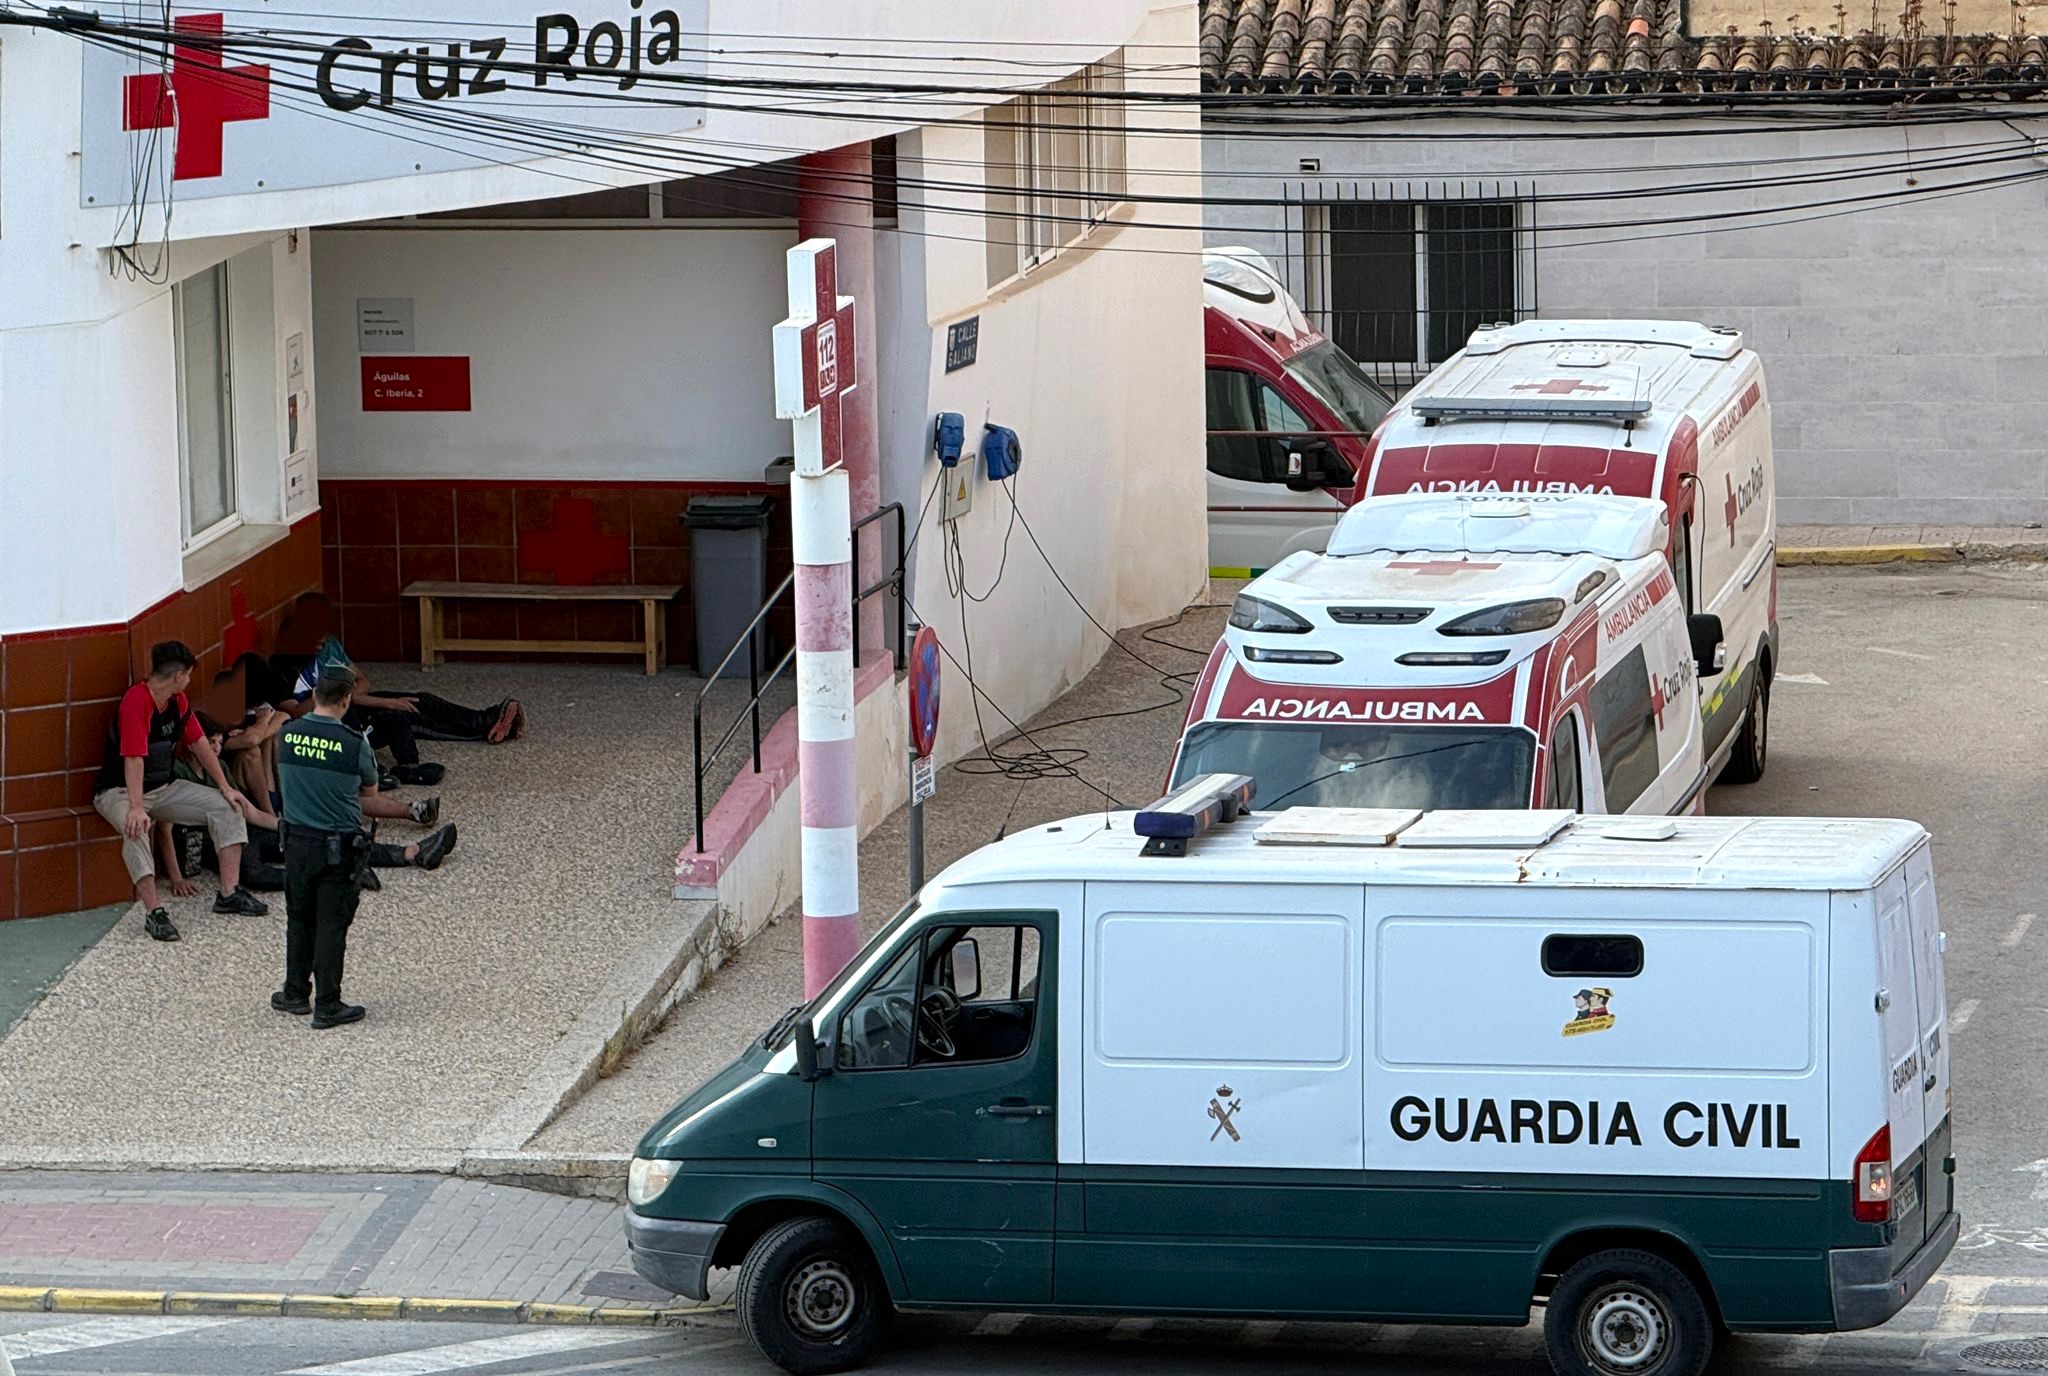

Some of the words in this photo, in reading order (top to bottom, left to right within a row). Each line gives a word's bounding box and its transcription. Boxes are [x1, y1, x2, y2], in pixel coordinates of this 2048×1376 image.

[316, 37, 506, 111] Cruz
[535, 0, 680, 91] Roja
[819, 335, 834, 366] 112
[373, 371, 410, 382] Águilas
[374, 389, 384, 398] C.
[386, 388, 415, 398] Iberia,
[417, 389, 424, 398] 2
[1712, 402, 1744, 449] AMBULANCIA
[1737, 483, 1752, 516] Cruz
[1751, 456, 1764, 500] Roja
[1605, 589, 1652, 643] AMBULANCIA
[1663, 672, 1681, 704] Cruz
[1679, 651, 1692, 688] Roja
[284, 733, 343, 753] GUARDIA
[294, 745, 327, 760] CIVIL
[1390, 1095, 1643, 1146] GUARDIA
[1663, 1100, 1801, 1149] CIVIL
